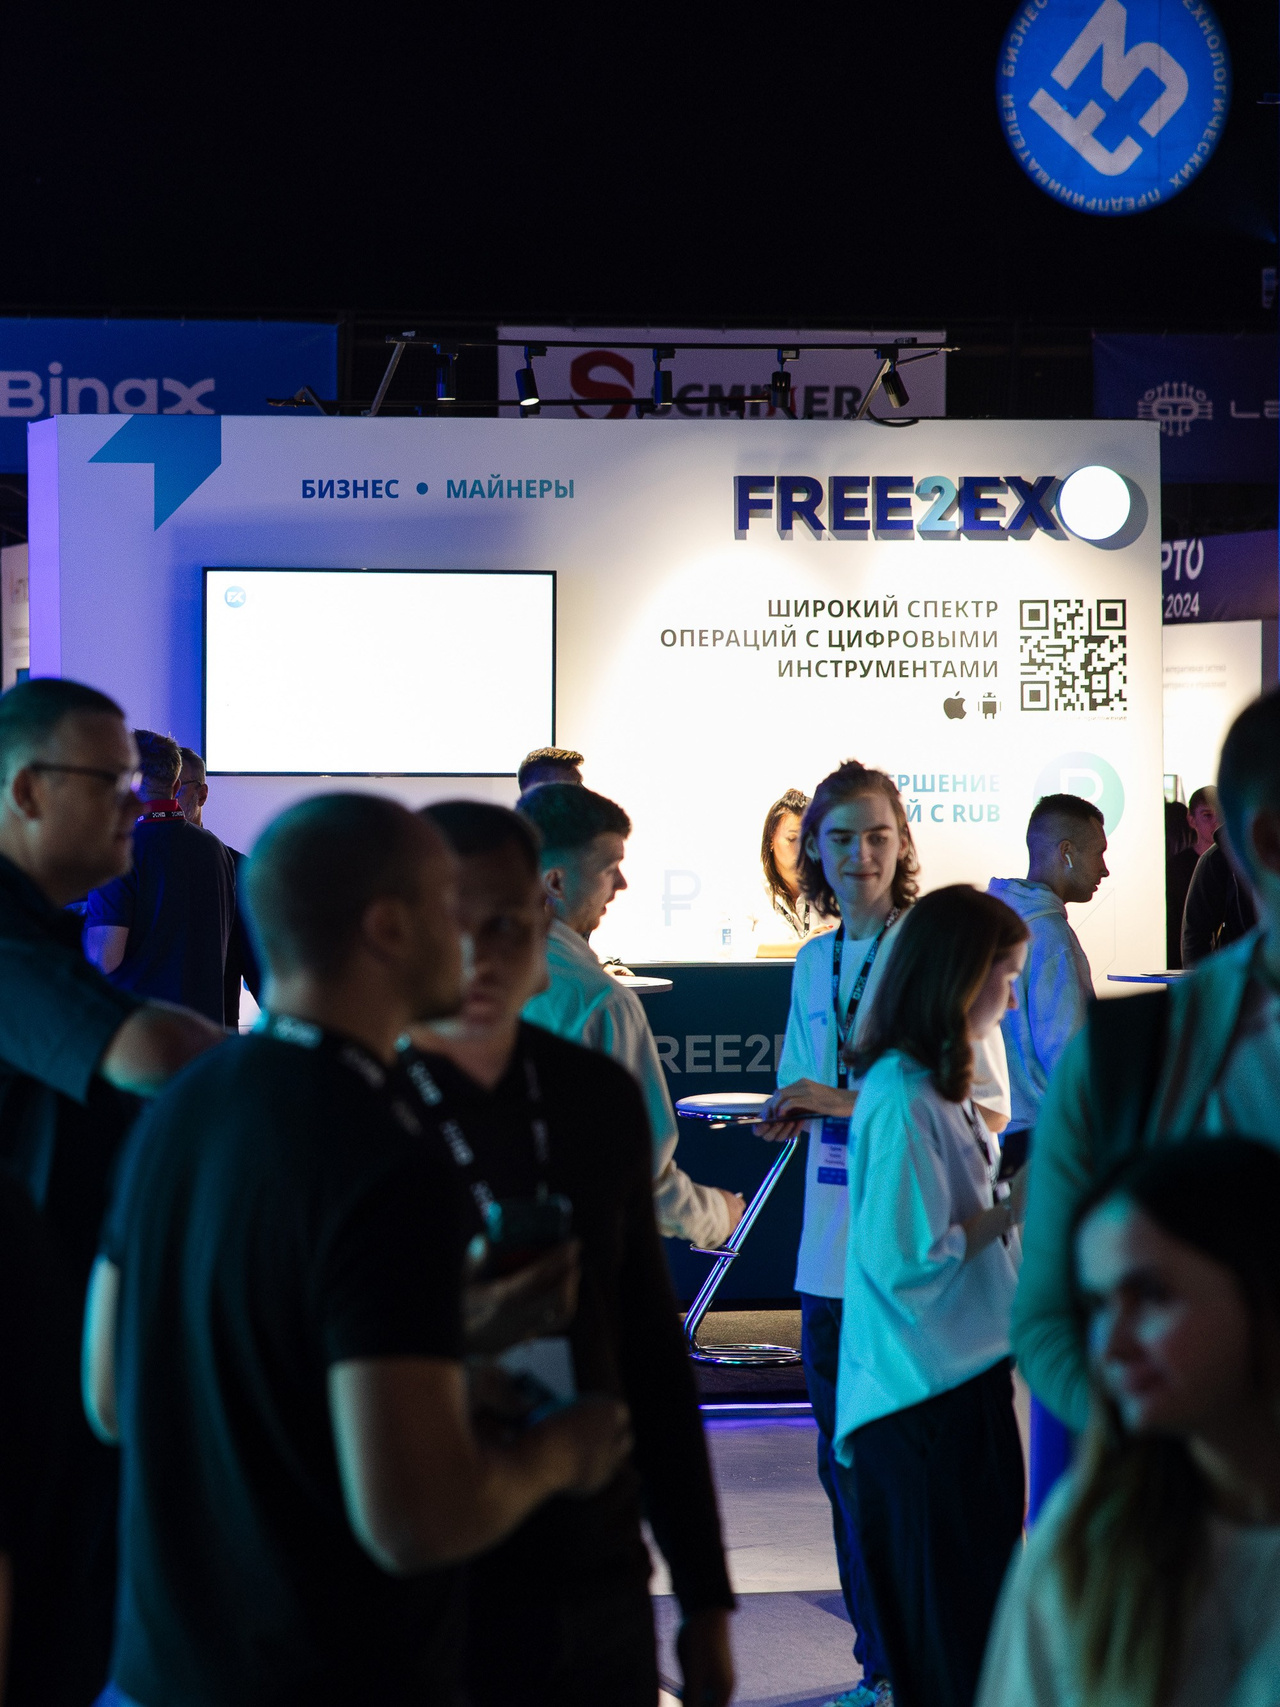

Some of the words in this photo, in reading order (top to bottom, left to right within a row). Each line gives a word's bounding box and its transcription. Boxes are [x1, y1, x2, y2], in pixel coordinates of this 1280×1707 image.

[301, 479, 399, 499] БИЗНЕС
[446, 474, 574, 499] МАЙНЕРЫ
[734, 475, 1058, 532] FREE2EX
[768, 595, 898, 618] ШИРОКИЙ
[907, 600, 998, 618] СПЕКТР
[1164, 591, 1200, 618] 2024
[660, 624, 797, 650] ОПЕРАЦИЙ
[806, 629, 819, 648] С
[828, 629, 998, 651] ЦИФРОВЫМИ
[778, 660, 998, 678] ИНСТРУМЕНТАМИ
[888, 774, 1000, 793] РШЕНИЕ
[931, 804, 944, 822] С
[953, 804, 1000, 822] RUB
[653, 1034, 786, 1073] REE2
